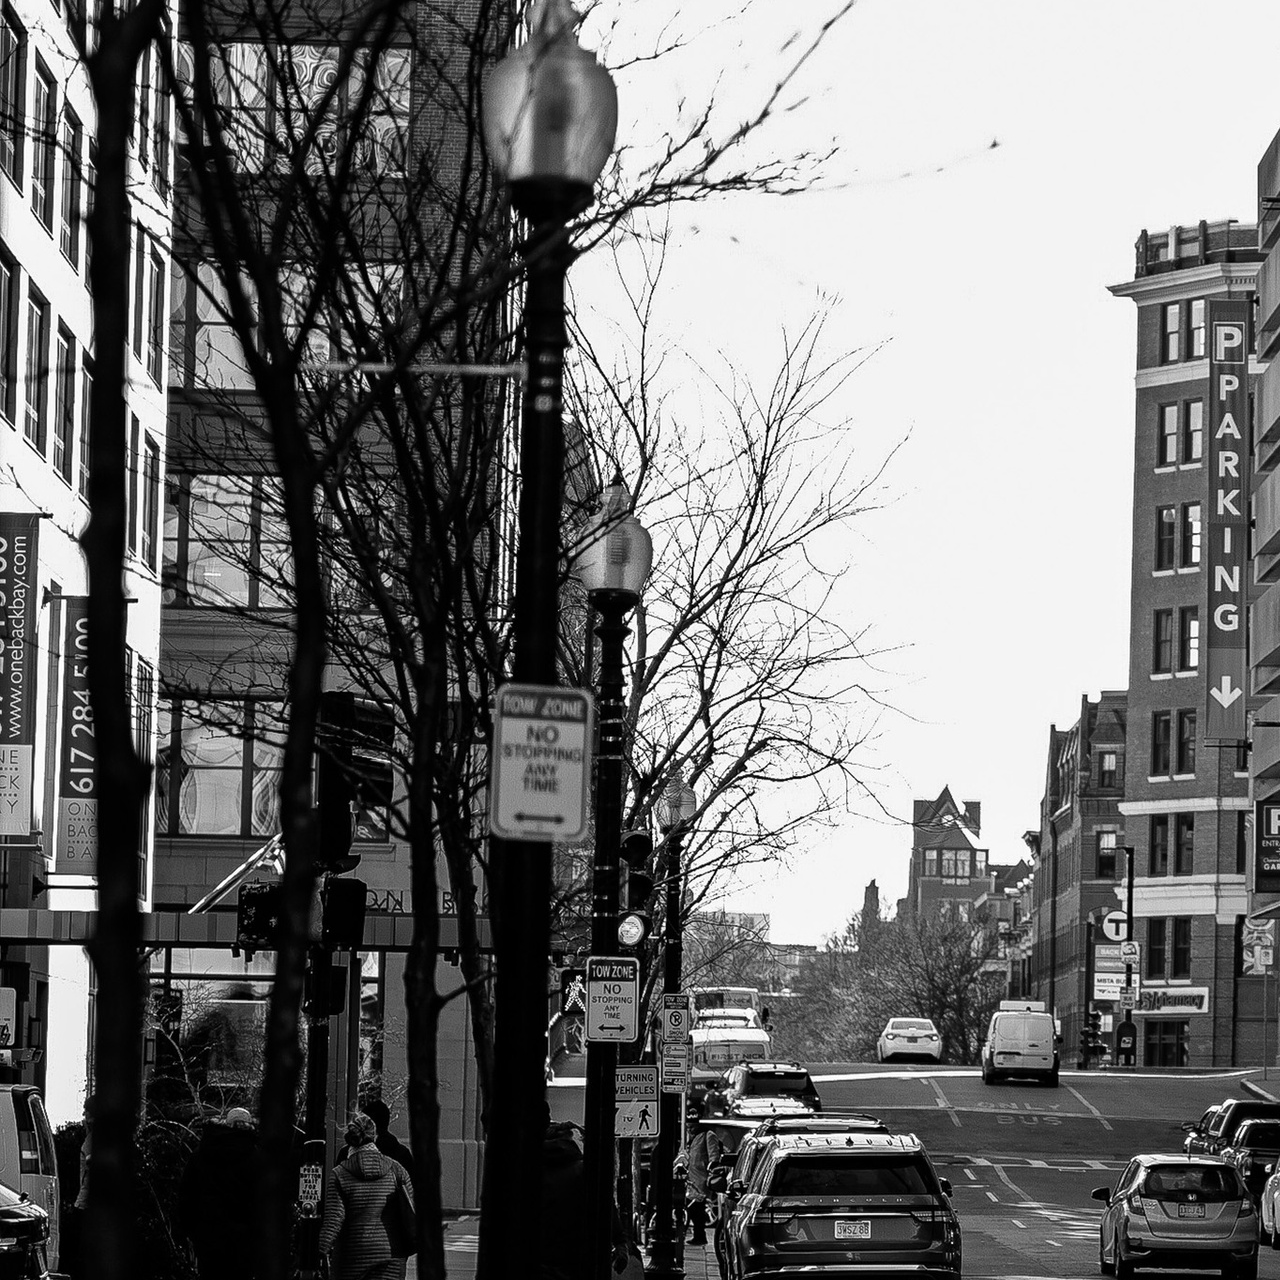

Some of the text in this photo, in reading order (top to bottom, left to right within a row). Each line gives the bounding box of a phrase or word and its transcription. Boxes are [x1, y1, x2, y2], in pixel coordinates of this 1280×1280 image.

[1217, 326, 1242, 361] P
[1214, 375, 1242, 631] PARKING
[7, 534, 30, 739] www.onebackbay.com
[72, 688, 95, 738] 284
[527, 725, 560, 744] NO
[69, 746, 94, 793] 617
[68, 802, 97, 816] ON
[67, 824, 98, 838] BAC
[66, 846, 93, 859] BA
[1107, 918, 1128, 937] T
[592, 965, 634, 979] TOW ZONE
[604, 984, 622, 995] NO
[592, 996, 633, 1004] STOPPING
[615, 1073, 654, 1082] TURNING
[616, 1086, 655, 1095] VEHICLES
[996, 1115, 1062, 1126] BUS
